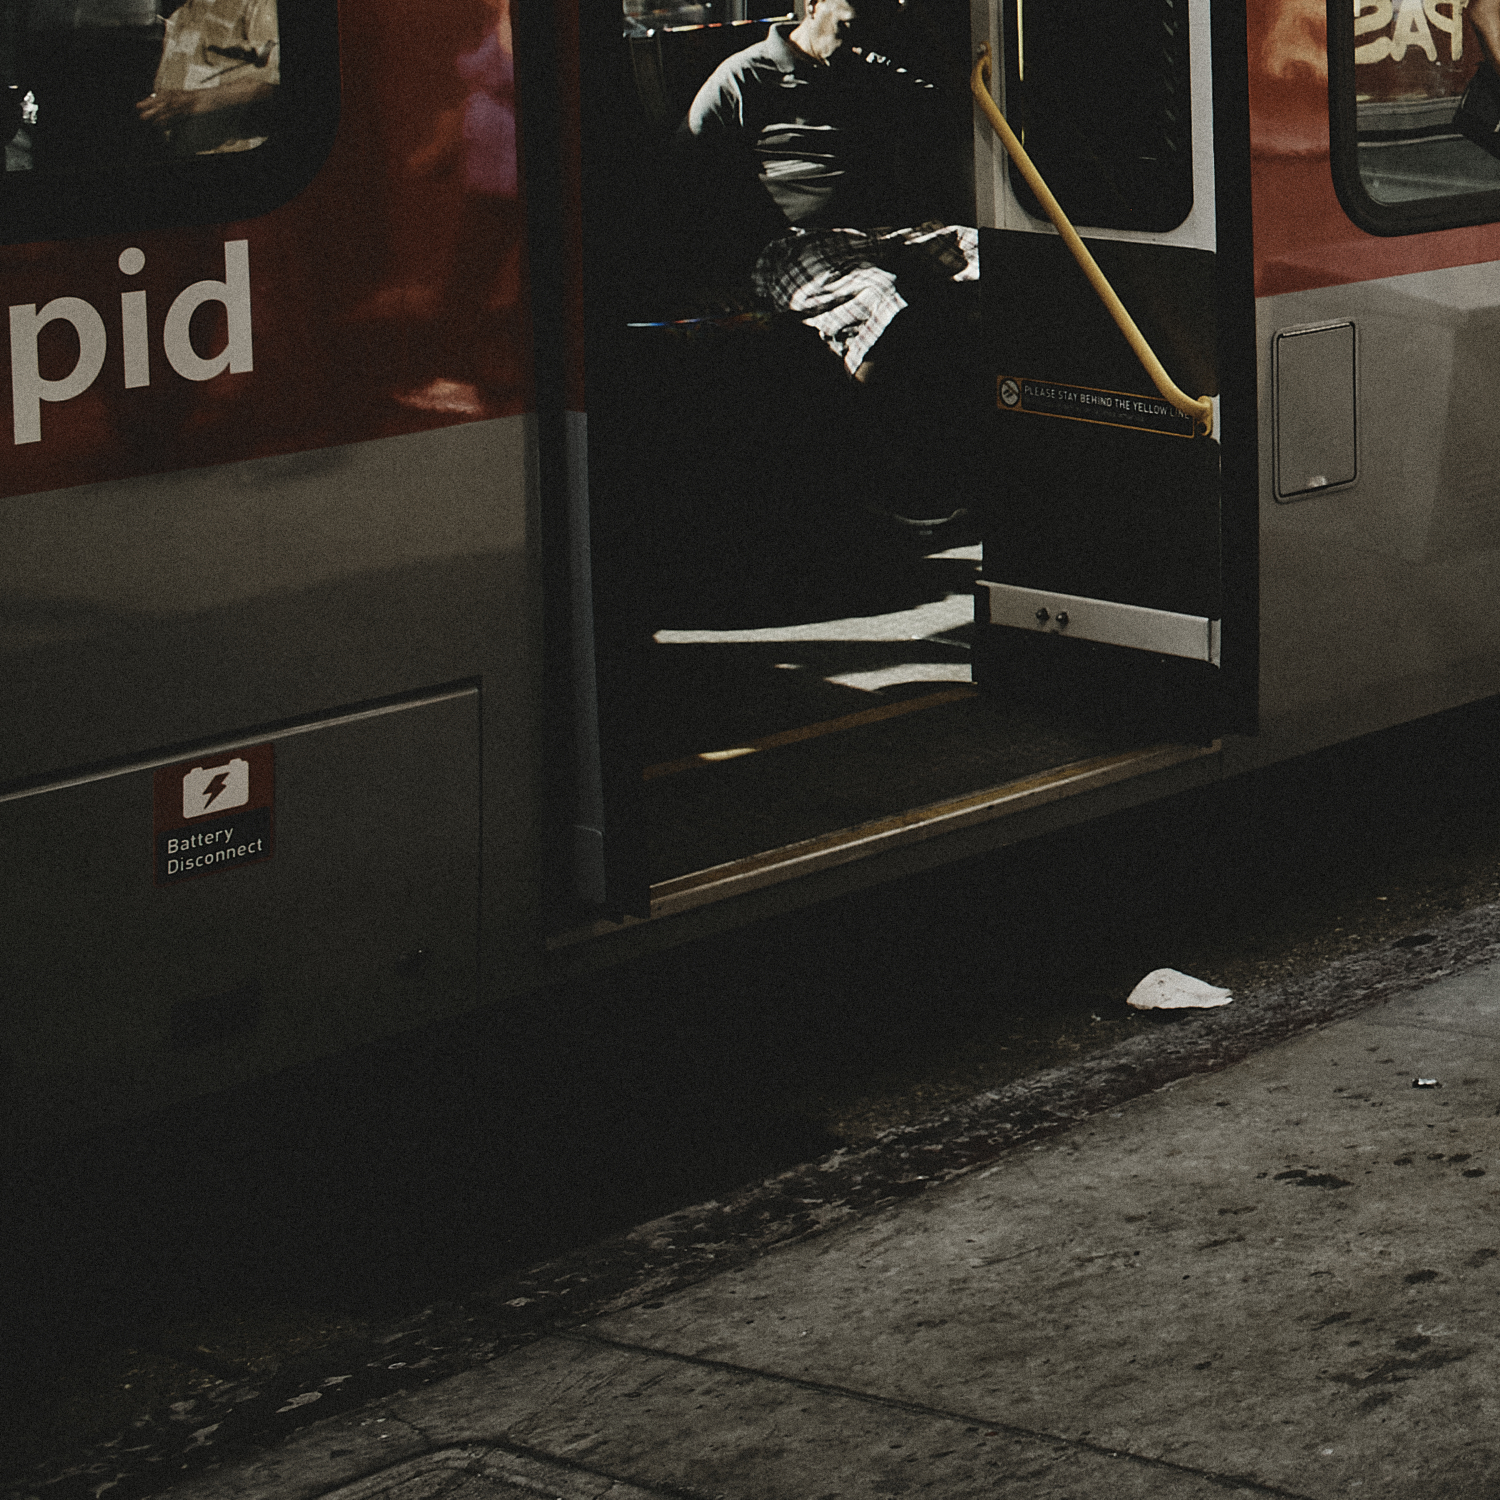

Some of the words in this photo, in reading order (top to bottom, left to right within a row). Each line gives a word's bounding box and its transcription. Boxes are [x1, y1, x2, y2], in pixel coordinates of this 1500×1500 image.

[9, 239, 253, 445] pid
[1024, 385, 1056, 399] PLEASE
[1058, 390, 1078, 402] STAY
[1080, 394, 1113, 408] BEHIND
[1115, 398, 1131, 411] THE
[1133, 401, 1168, 416] YELLOW
[167, 827, 234, 855] Battery
[167, 838, 263, 875] Disconnect
